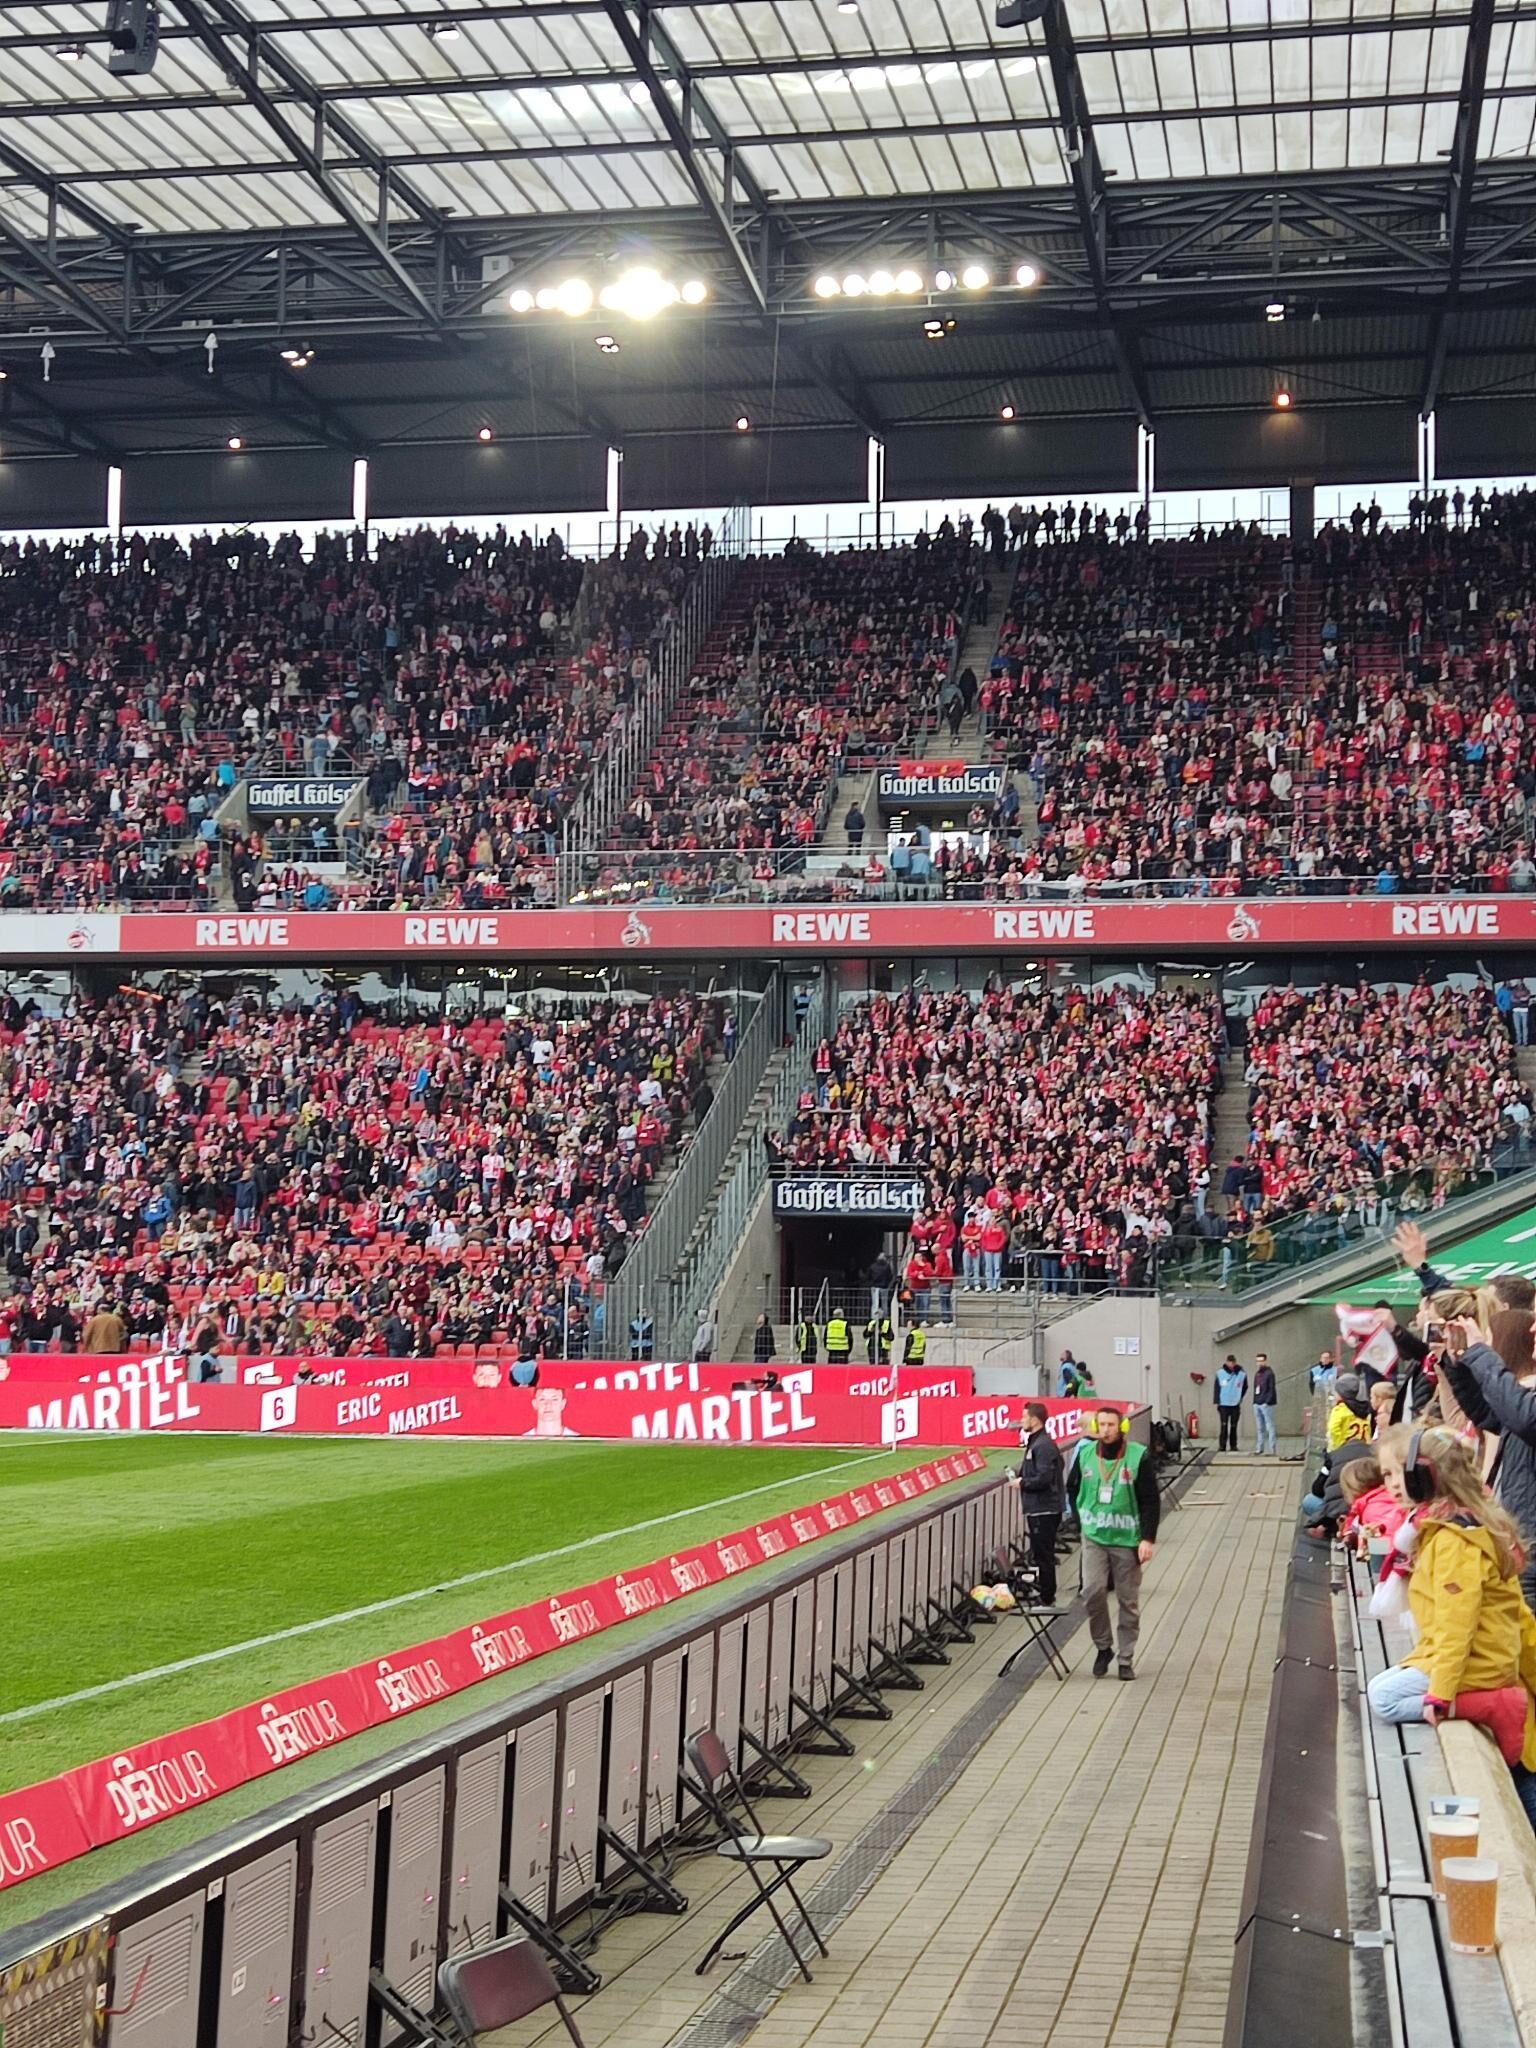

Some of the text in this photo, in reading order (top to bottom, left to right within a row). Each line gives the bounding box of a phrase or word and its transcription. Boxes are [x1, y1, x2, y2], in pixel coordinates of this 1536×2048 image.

[249, 783, 357, 806] Gaffel Kölsc
[195, 918, 289, 946] REWE
[404, 917, 498, 945] REWE
[772, 912, 871, 941] REWE
[993, 909, 1095, 938] REWE
[1392, 904, 1499, 935] REWE
[777, 1182, 843, 1211] Gaffel
[27, 1381, 201, 1429] MARTEL
[274, 1397, 283, 1420] 6
[337, 1393, 382, 1425] ERIC
[388, 1396, 462, 1434] MARTEL
[631, 1390, 816, 1441] MARTEL
[895, 1408, 906, 1433] 6
[962, 1405, 1010, 1439] ERIC
[256, 1699, 347, 1765] DERTOUR
[106, 1750, 218, 1827] DERTOUR
